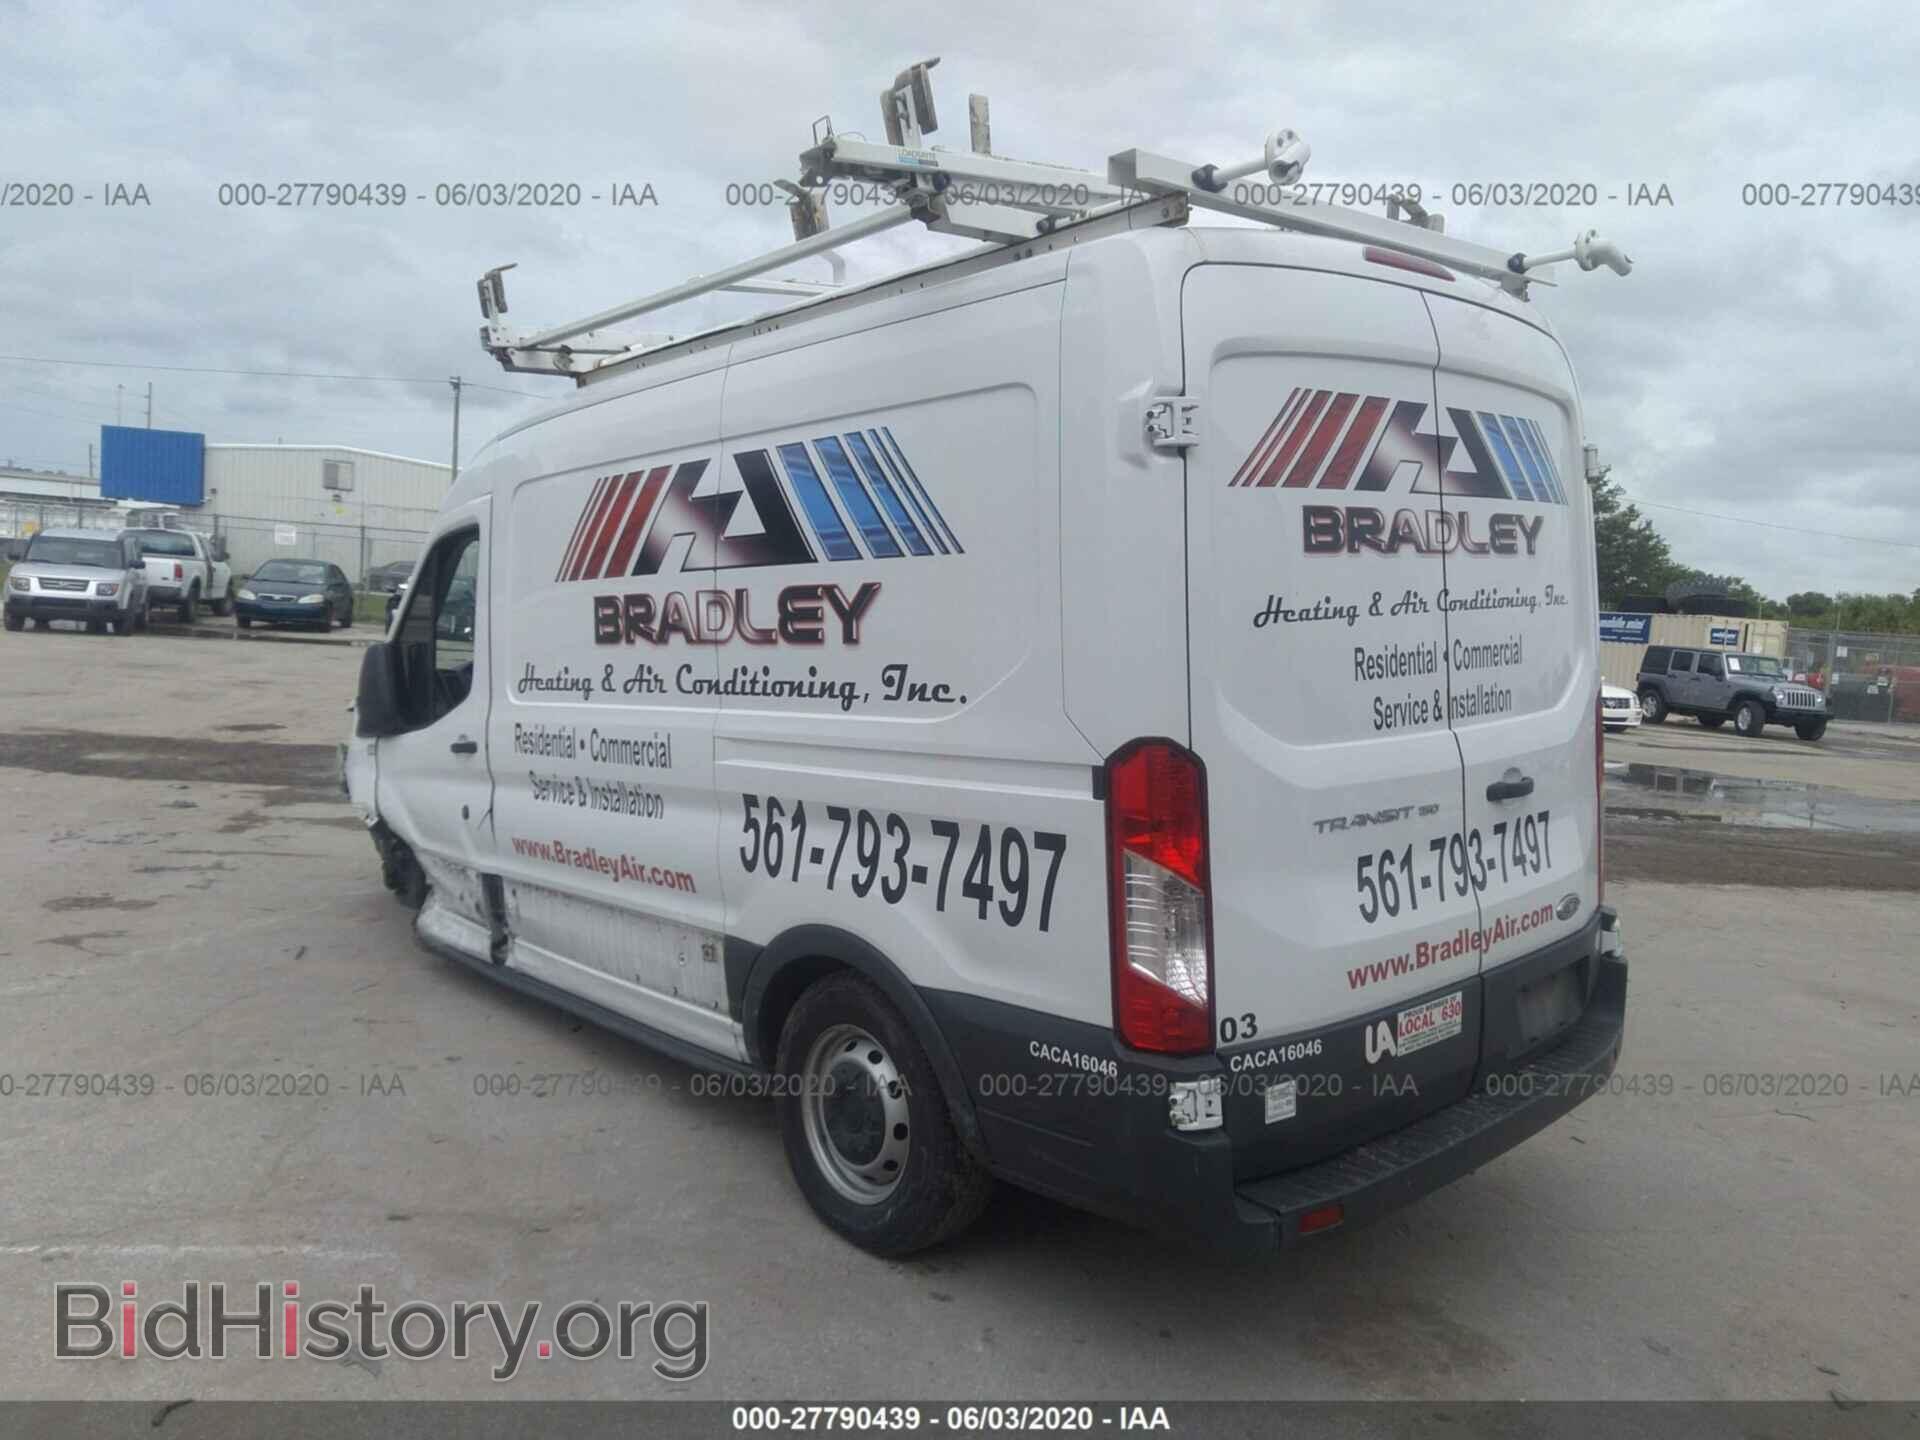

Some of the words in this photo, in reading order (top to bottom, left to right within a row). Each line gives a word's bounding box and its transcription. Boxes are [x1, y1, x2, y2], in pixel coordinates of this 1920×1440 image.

[1302, 504, 1545, 556] BRADLEY
[593, 581, 882, 646] BRADLEY
[1253, 595, 1360, 627] Heating
[1368, 592, 1385, 617] &
[1391, 589, 1431, 615] Air
[1354, 641, 1437, 682] Residential
[1453, 634, 1522, 671] Commercial
[518, 662, 594, 700] Heating
[601, 663, 616, 693] &
[623, 664, 668, 694] Air
[881, 664, 968, 705] Inc.
[1373, 691, 1429, 730] Service
[1433, 689, 1443, 722] &
[1447, 682, 1512, 720] Installation
[515, 722, 576, 760] Residential
[590, 728, 672, 769] Commercial
[528, 770, 574, 805] Service
[575, 776, 587, 807] &
[586, 777, 664, 819] Installation
[512, 837, 697, 893] www.BradleyAir.com
[739, 793, 1067, 932] 561-793-7497
[1357, 810, 1552, 924] 561-793-7497
[1347, 904, 1553, 989] www.BradleyAir.com
[1220, 1013, 1258, 1043] 03
[1398, 1012, 1435, 1037] LOCAL
[1441, 1001, 1461, 1021] 630
[1030, 1041, 1118, 1078] CACA16046
[1230, 1039, 1322, 1072] CACA16046
